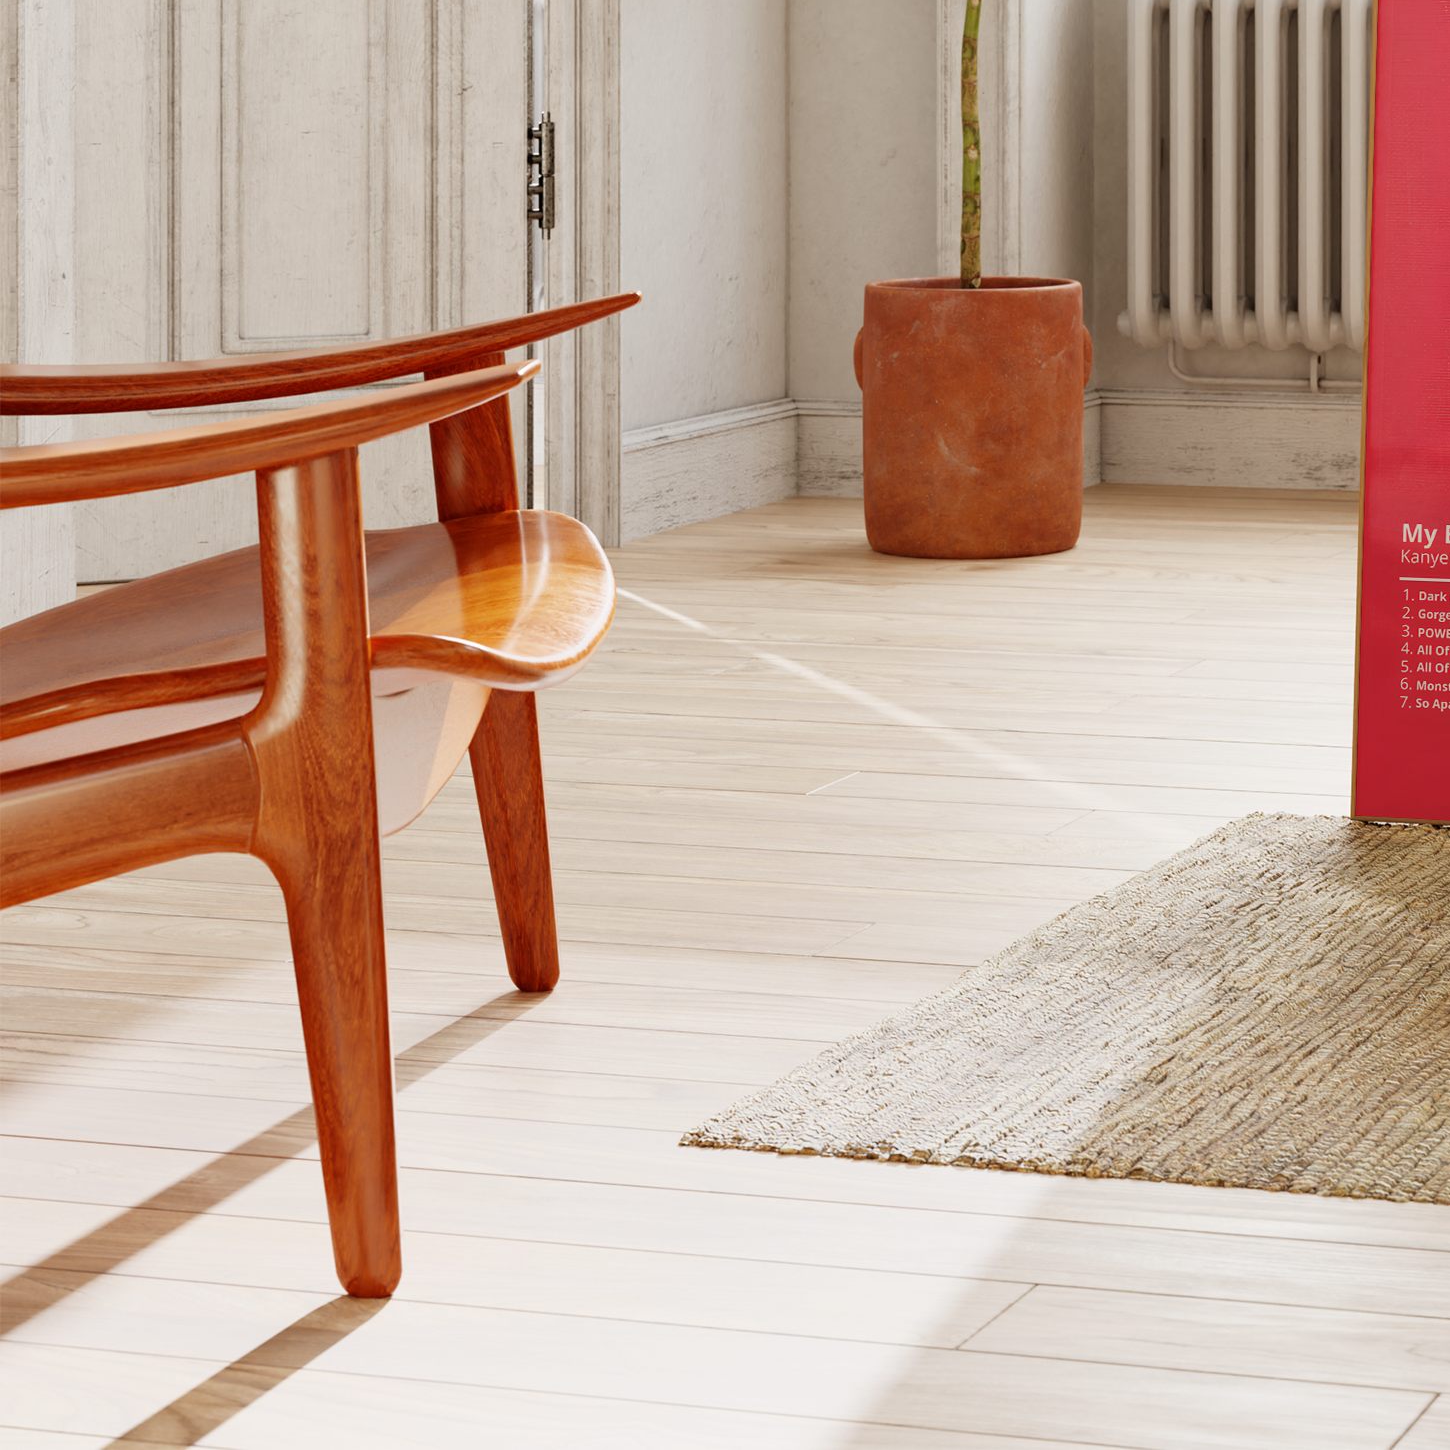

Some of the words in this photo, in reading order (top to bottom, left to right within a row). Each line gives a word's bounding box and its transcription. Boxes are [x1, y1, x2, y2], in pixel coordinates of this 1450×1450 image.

[1401, 522, 1439, 550] My
[1400, 548, 1449, 569] Kanye
[1403, 588, 1415, 602] 1.
[1418, 590, 1448, 602] Dark
[1401, 606, 1415, 620] 2.
[1401, 624, 1414, 638] 3.
[1400, 641, 1413, 655] 4.
[1416, 644, 1433, 656] All
[1400, 659, 1413, 674] 5.
[1416, 661, 1432, 673] All
[1434, 662, 1450, 674] Of
[1400, 677, 1413, 691] 6.
[1399, 695, 1412, 709] 7.
[1415, 697, 1430, 709] So
